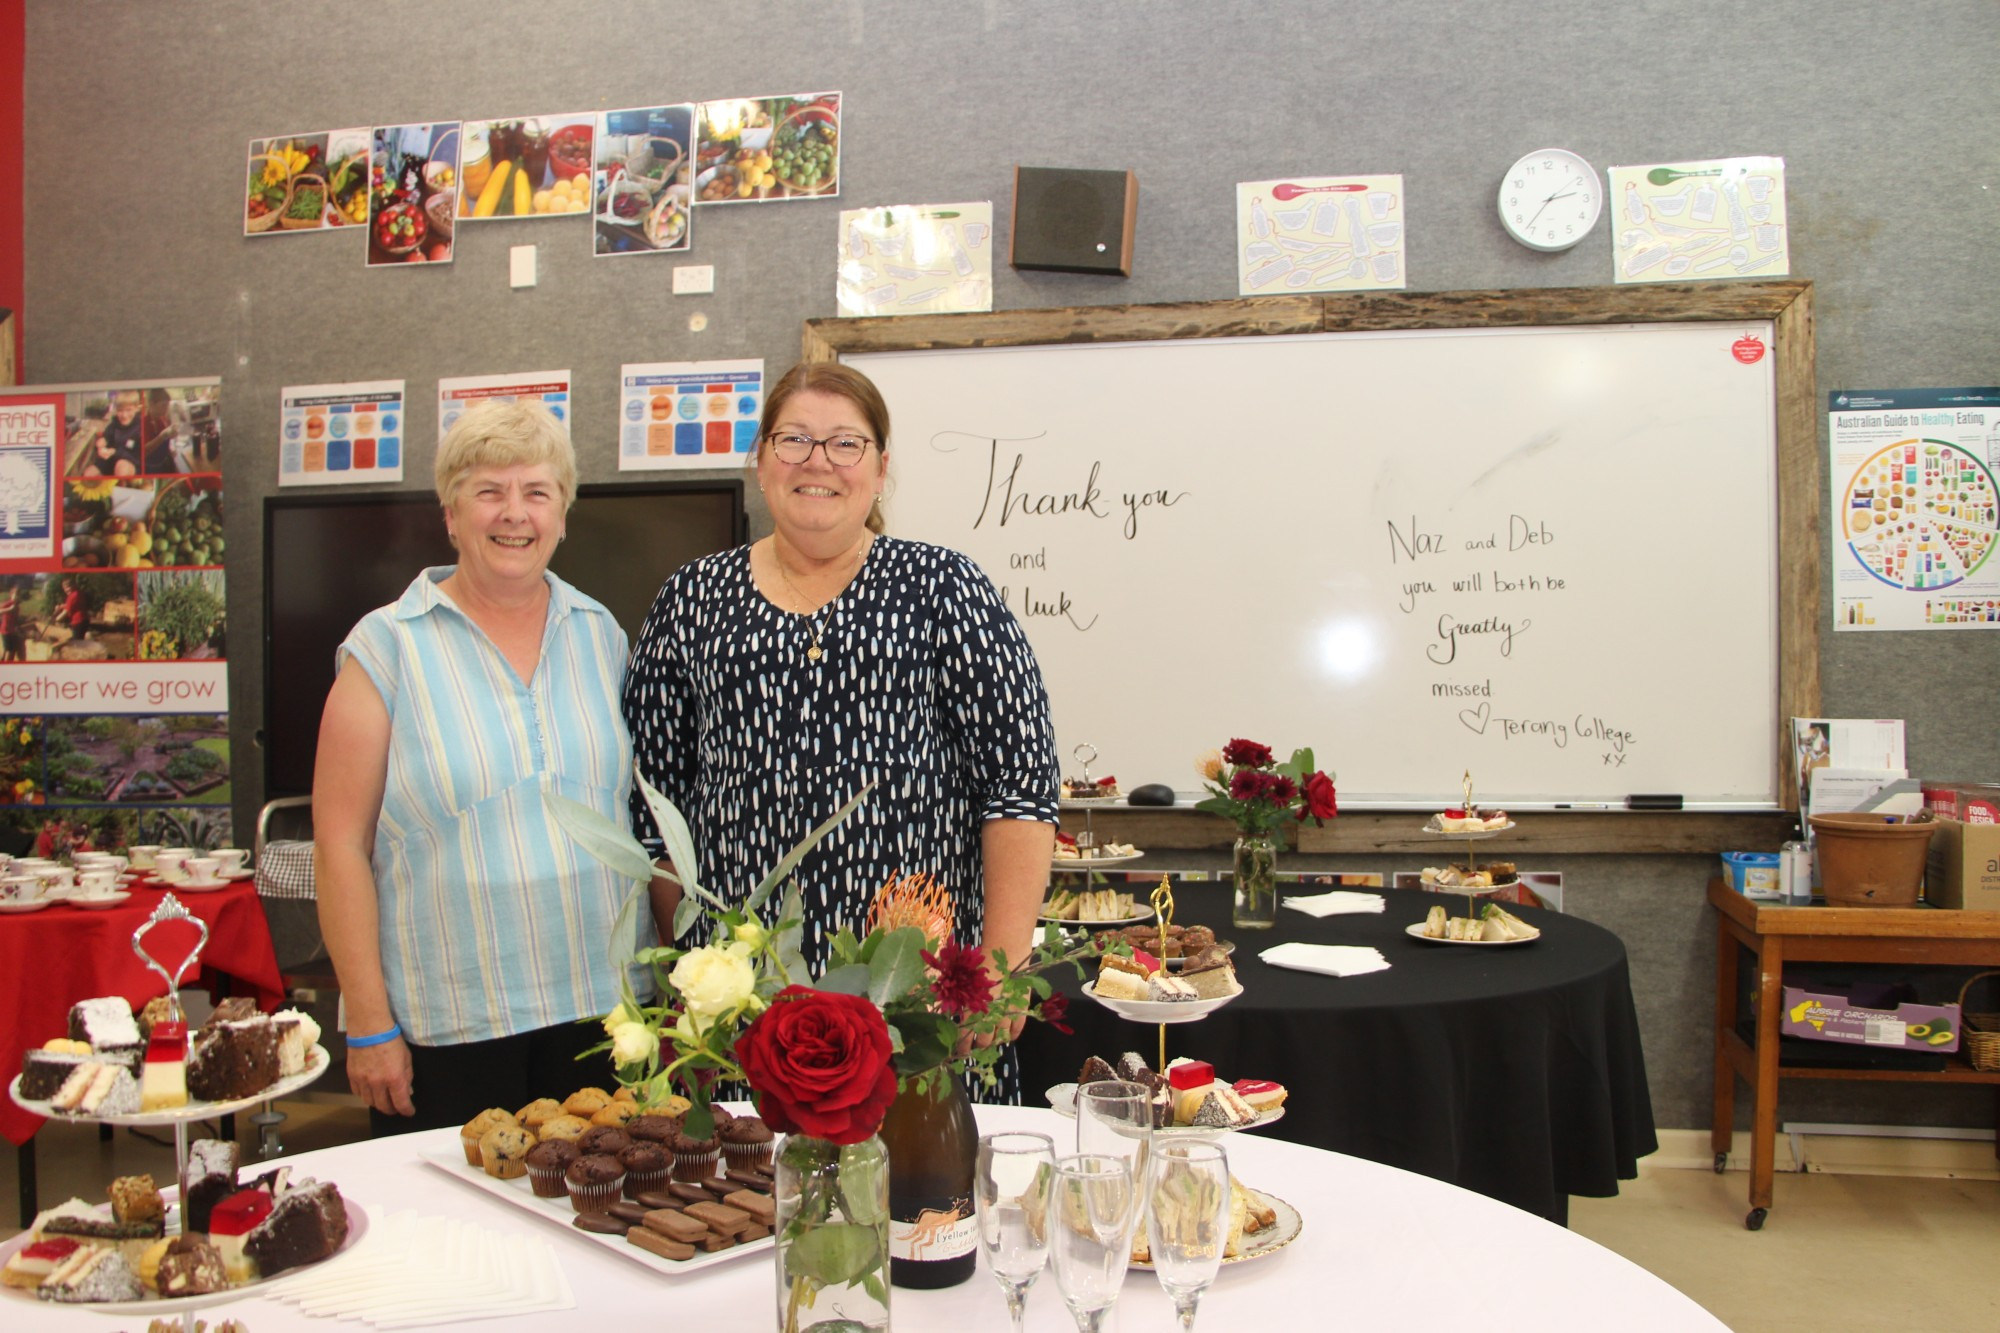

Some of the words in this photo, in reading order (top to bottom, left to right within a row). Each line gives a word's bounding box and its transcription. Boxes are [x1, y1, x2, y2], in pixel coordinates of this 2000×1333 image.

[1543, 160, 1553, 170] 12
[1564, 165, 1569, 173] 1
[1526, 166, 1535, 175] 11
[1514, 179, 1524, 189] 10
[1576, 176, 1583, 186] 2
[1510, 197, 1517, 206] 9
[1583, 193, 1590, 203] 3
[1515, 214, 1523, 223] 8
[1578, 211, 1585, 220] 4
[1530, 226, 1536, 235] 7
[1566, 225, 1573, 234] 5
[1547, 230, 1555, 240] 6
[1837, 415, 1882, 428] Australian
[1884, 414, 1908, 427] Guide
[1910, 414, 1919, 426] to
[1922, 413, 1954, 427] Healthy
[1957, 412, 1985, 425] Eating
[930, 430, 1109, 529] Thank
[1123, 488, 1192, 540] you
[1388, 514, 1446, 564] Naz
[1465, 532, 1496, 550] and
[1509, 514, 1553, 552] Deb
[1010, 547, 1046, 571] and
[1399, 581, 1436, 613] you
[1452, 572, 1482, 592] will
[1494, 570, 1540, 592] both
[1547, 576, 1566, 590] be
[1024, 587, 1099, 631] luck
[1426, 613, 1531, 665] Greatly
[97, 680, 138, 699] we
[147, 680, 215, 705] grow
[1492, 717, 1567, 748] Terang
[1575, 714, 1637, 752] College
[1968, 805, 1987, 815] FOOD
